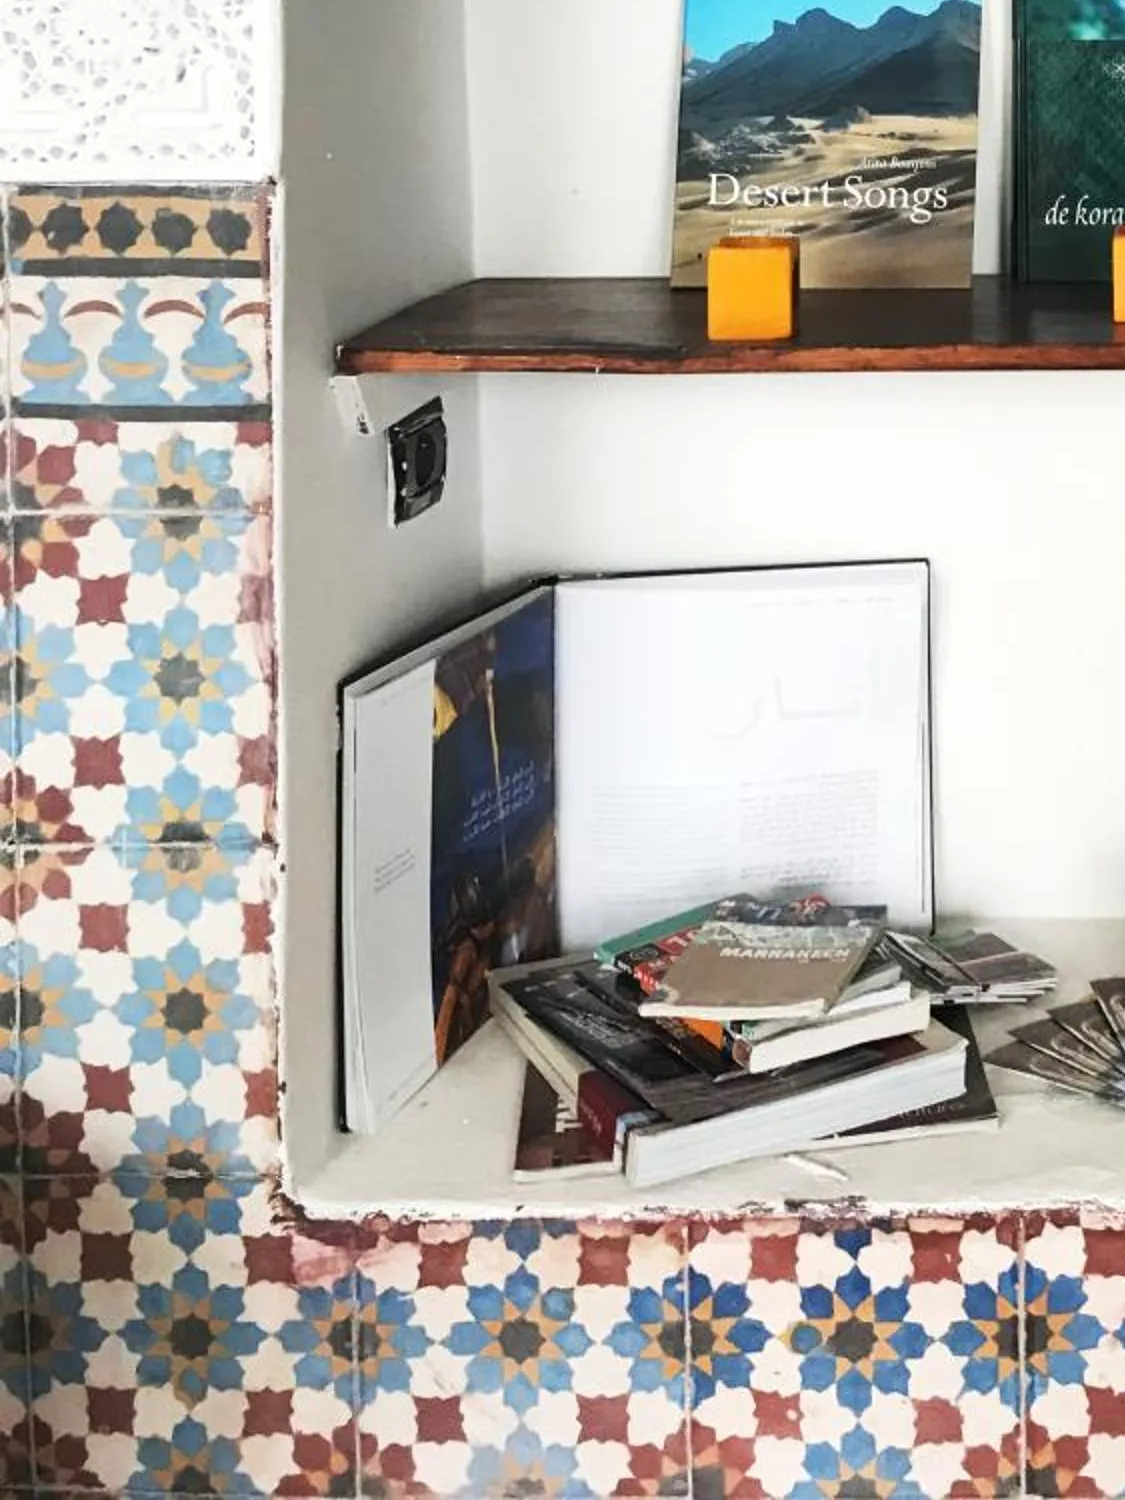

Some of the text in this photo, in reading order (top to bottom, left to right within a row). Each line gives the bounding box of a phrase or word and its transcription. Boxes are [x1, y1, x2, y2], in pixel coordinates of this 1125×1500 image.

[707, 172, 948, 225] Desert Songs
[1045, 195, 1069, 226] de
[719, 946, 851, 960] MARRAKECH
